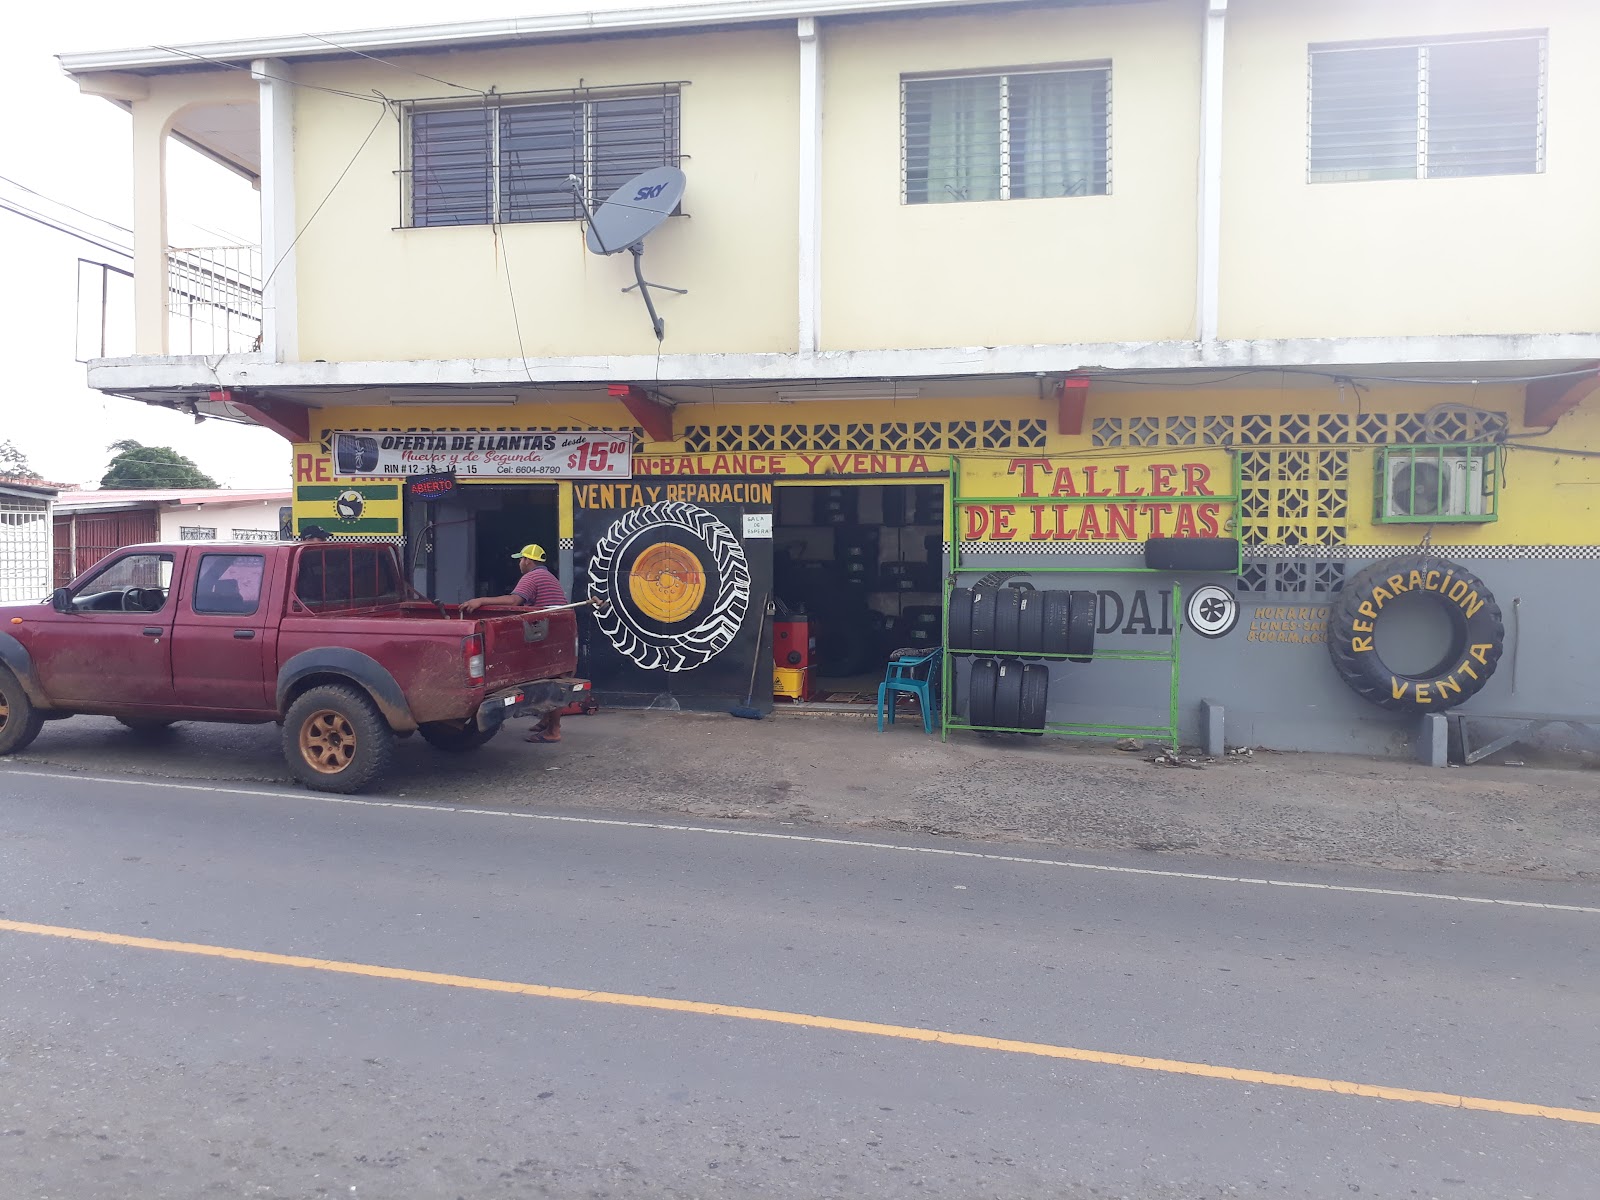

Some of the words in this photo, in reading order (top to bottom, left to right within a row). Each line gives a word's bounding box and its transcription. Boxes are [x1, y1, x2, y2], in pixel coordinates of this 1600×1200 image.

[634, 182, 669, 201] SKY
[381, 436, 447, 450] OFERTA
[451, 436, 475, 451] DE
[478, 435, 557, 451] LLANTAS
[561, 436, 586, 448] desde
[401, 450, 446, 463] Nuevas
[450, 454, 461, 465] y
[463, 451, 480, 462] de
[484, 450, 543, 466] Segunda
[800, 454, 824, 474] Y
[830, 453, 930, 474] VENTA
[384, 464, 399, 474] RIN
[446, 464, 457, 474] 14
[467, 464, 477, 474] 15
[496, 465, 513, 474] Cel:
[515, 465, 561, 474] 6604-8790
[1008, 457, 1215, 497] TALLER
[411, 480, 452, 493] ABIERTO
[574, 483, 645, 509] VENTA
[646, 486, 662, 503] Y
[666, 483, 772, 505] REPARACION
[965, 503, 1018, 541] DE
[1030, 503, 1220, 541] LLANTAS
[1254, 607, 1329, 620] HORARIO
[1391, 643, 1493, 704] VENTA
